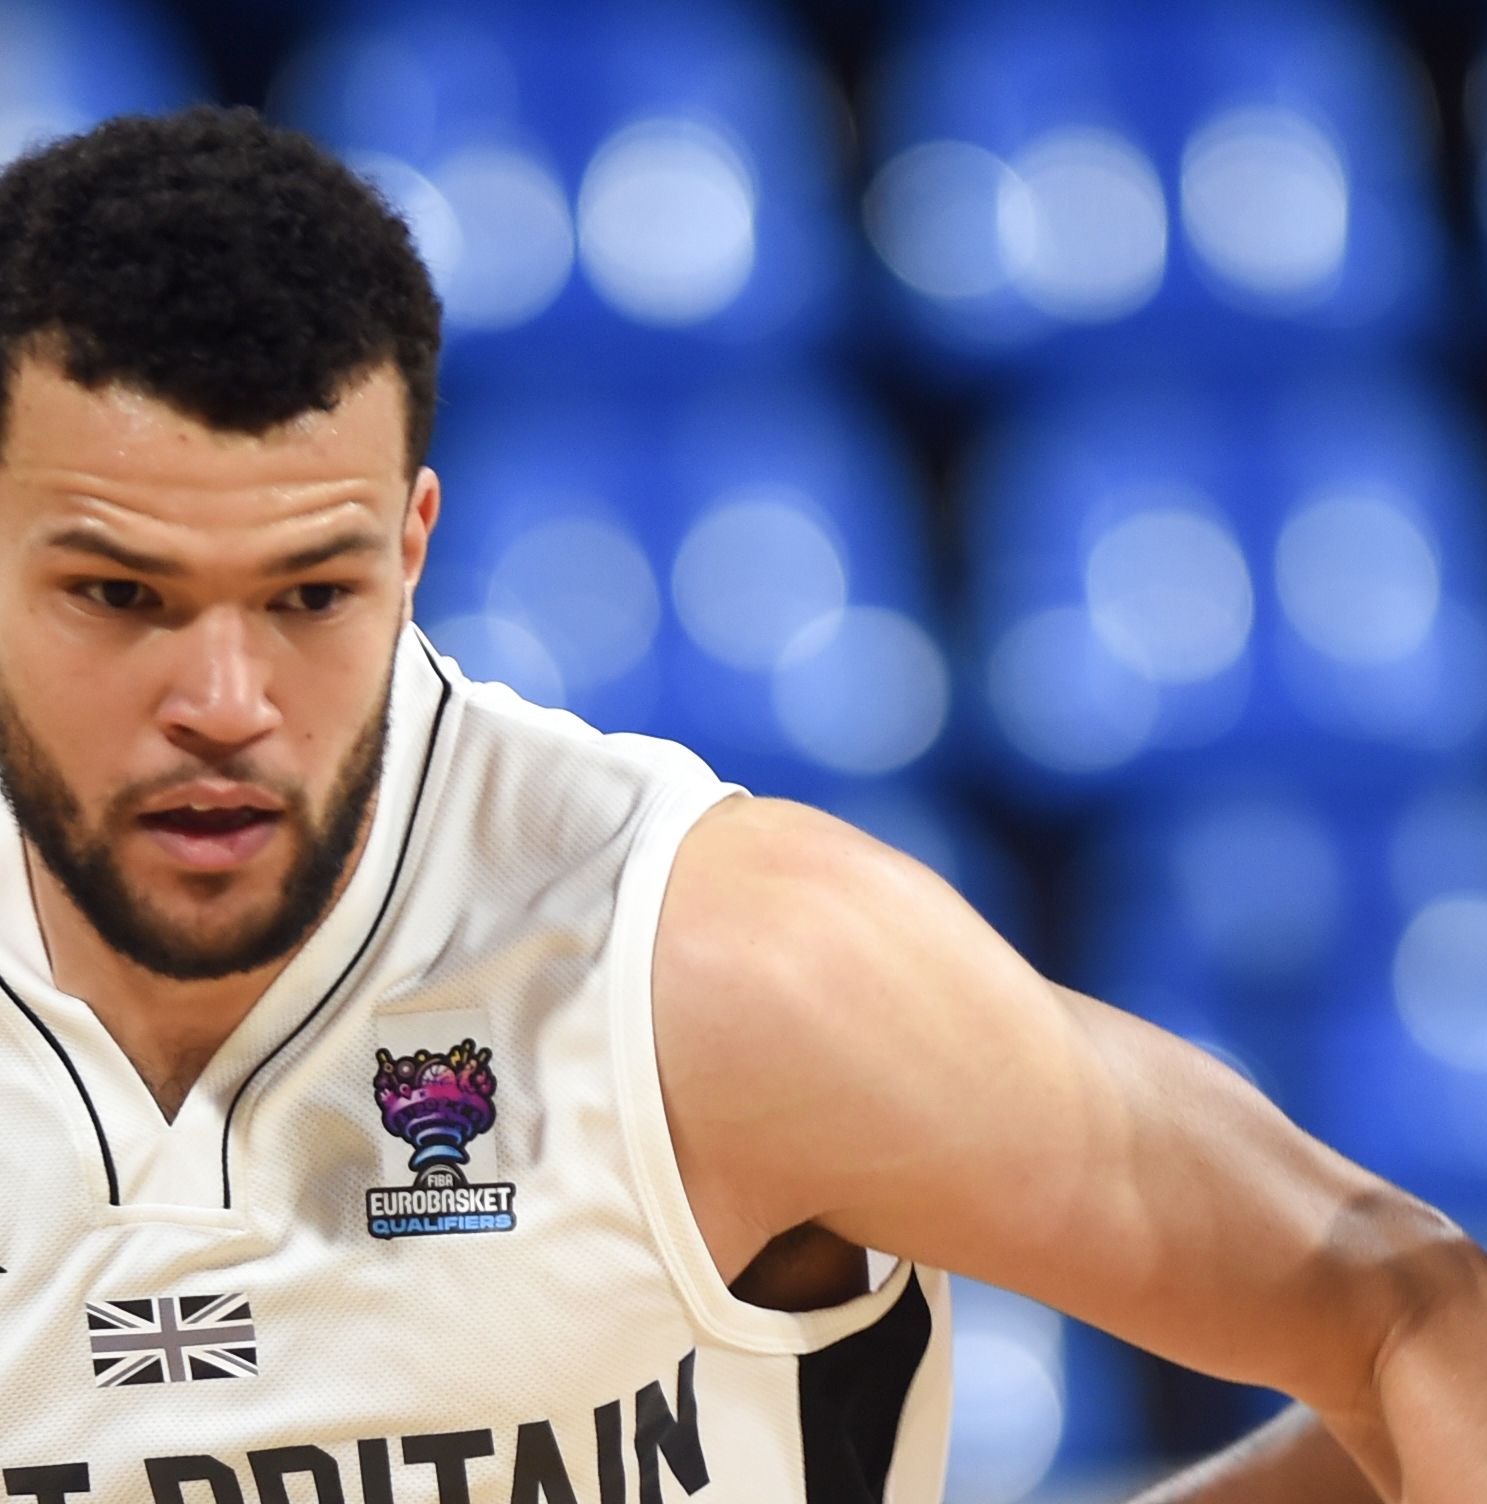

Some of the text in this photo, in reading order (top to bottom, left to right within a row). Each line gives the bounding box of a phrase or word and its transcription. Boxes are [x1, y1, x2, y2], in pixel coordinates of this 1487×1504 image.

[427, 1173, 454, 1188] FIBA
[370, 1187, 512, 1217] EUROBASKET
[372, 1213, 513, 1236] QUALIFIERS
